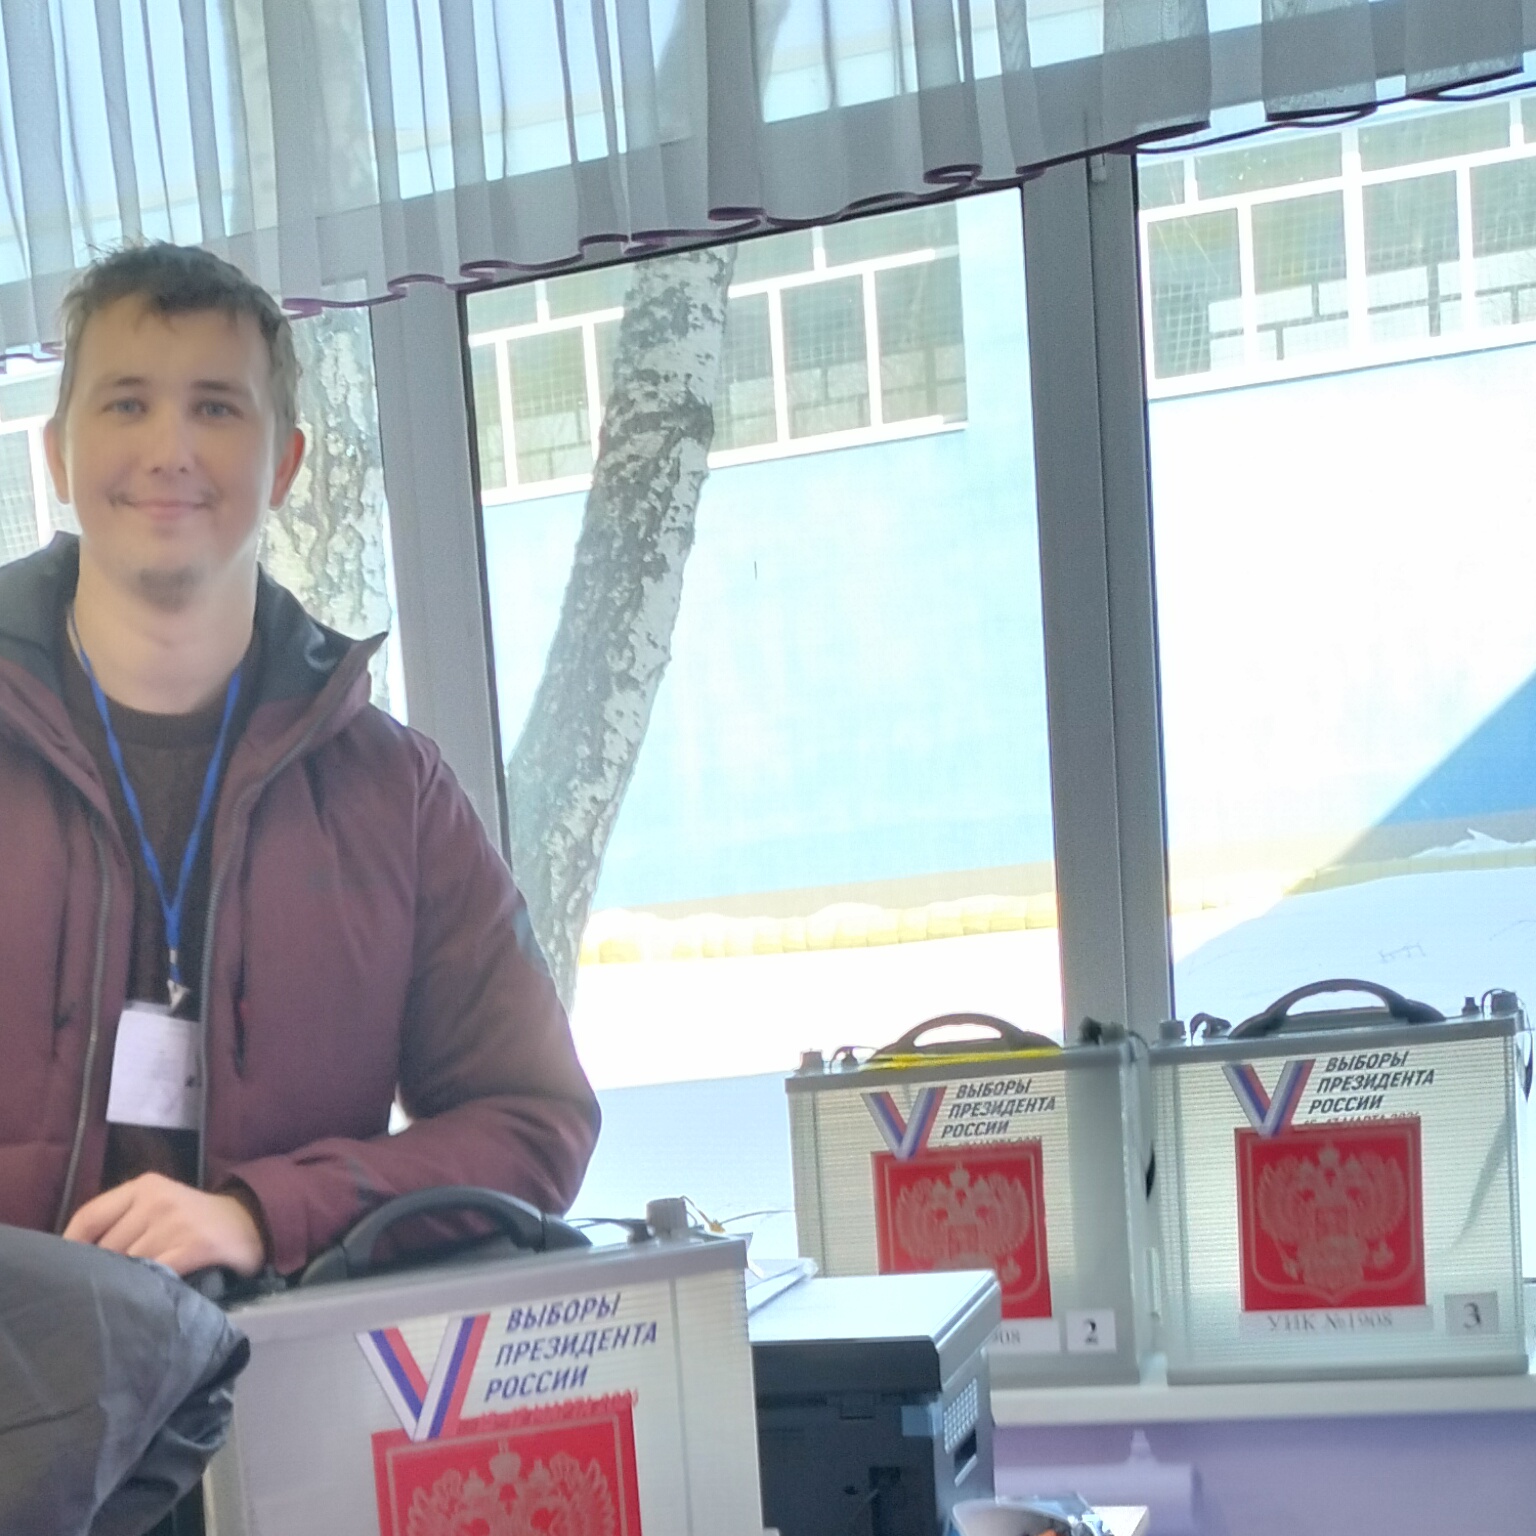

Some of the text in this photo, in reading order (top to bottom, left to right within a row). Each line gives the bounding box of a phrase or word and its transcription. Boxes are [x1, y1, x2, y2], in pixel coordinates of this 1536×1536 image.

[1325, 1051, 1409, 1073] ВЫБОРЫ
[956, 1078, 1032, 1099] ВЫБОРЫ
[1317, 1069, 1435, 1093] ПРЕЗИДЕНТА
[948, 1096, 1056, 1119] ПРЕЗИДЕНТА
[1308, 1095, 1384, 1114] РОССИИ
[941, 1120, 1010, 1139] РОССИИ
[506, 1292, 621, 1333] ВЫБОРЫ
[1463, 1302, 1482, 1330] 3
[1083, 1318, 1099, 1345] 2
[495, 1321, 657, 1367] ПРЕЗИДЕНТА
[484, 1365, 589, 1403] РОССИИ
